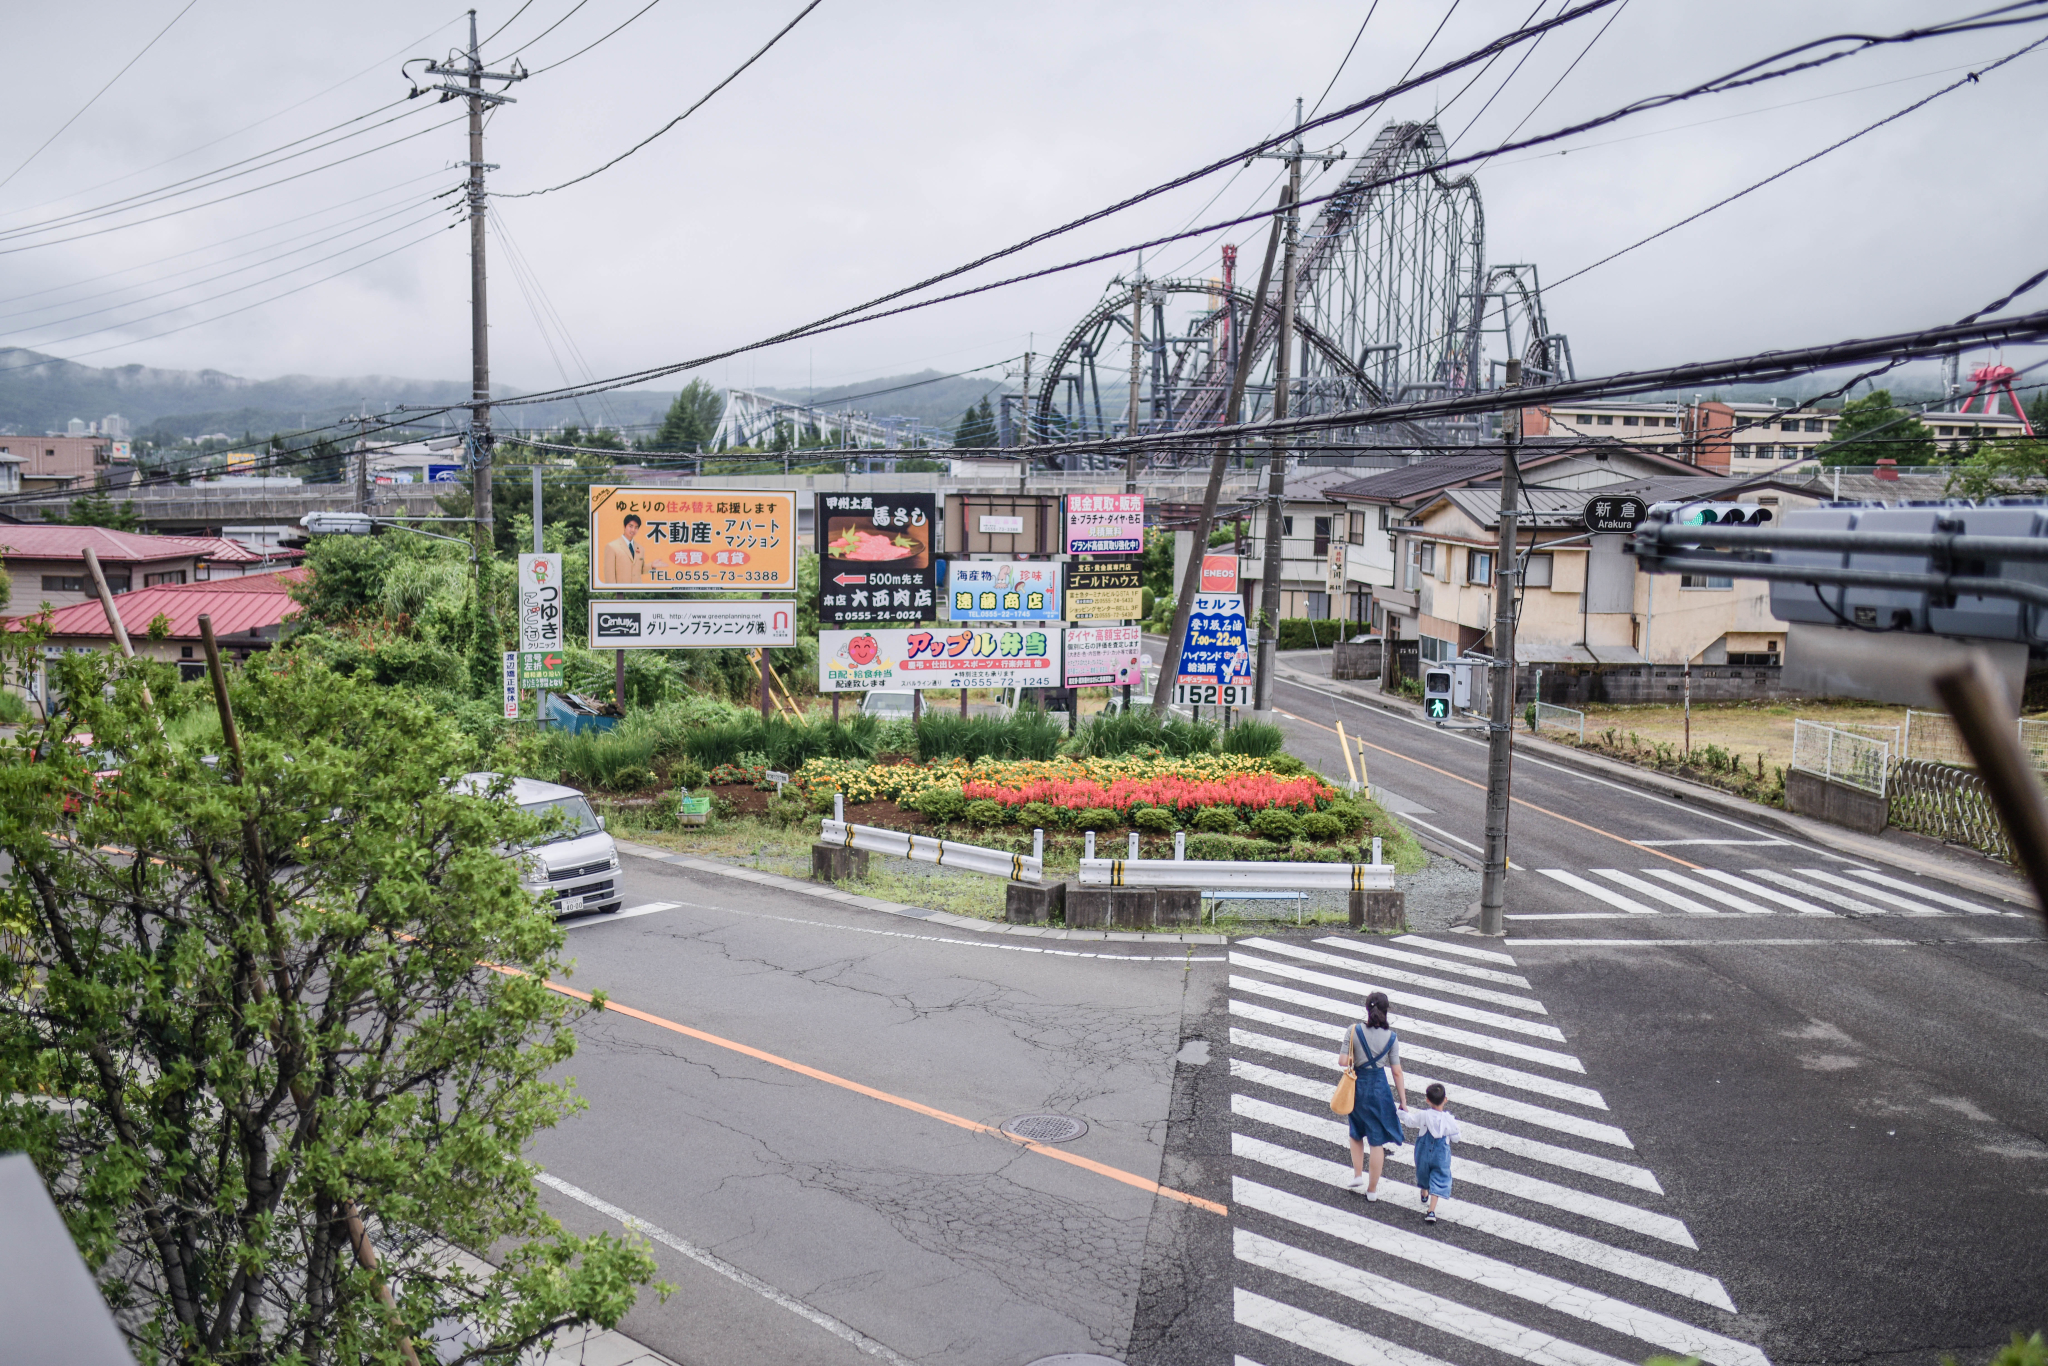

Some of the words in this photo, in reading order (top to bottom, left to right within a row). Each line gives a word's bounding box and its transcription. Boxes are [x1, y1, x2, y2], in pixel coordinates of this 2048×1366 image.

[616, 501, 777, 514] ゆとりの住み替え応援します
[826, 497, 873, 510] 甲州土産
[1070, 496, 1141, 512] 現金買取・販売
[872, 506, 926, 527] 馬さし
[1070, 513, 1141, 525] 金・プラチナ・ダイヤ・色石
[725, 519, 780, 534] アパート
[1598, 519, 1632, 529] Arakura
[1088, 526, 1122, 537] 見積無料
[725, 535, 780, 549] マンション
[674, 551, 704, 565] 売買
[715, 551, 745, 565] 賃貸
[1078, 563, 1132, 572] 宝石・貴金属専門店
[1203, 569, 1235, 578] ENEOS
[869, 573, 923, 585] 500m先左
[957, 570, 992, 581] 海産物
[1020, 570, 1043, 581] 珍味
[1070, 575, 1139, 588] ゴールドハウス
[823, 594, 847, 606] 本店
[851, 589, 932, 607] 大西肉店
[955, 591, 1044, 610] 遠藤商店
[1196, 599, 1241, 610] セルフ
[524, 591, 540, 642] こども
[540, 586, 558, 640] つゆき
[1191, 618, 1243, 631] 登り坂石油
[1068, 628, 1139, 642] ダイヤ・高額宝石は
[907, 630, 1047, 658] アップル弁当
[524, 653, 542, 663] 信号
[1183, 651, 1222, 661] ハイランド
[524, 662, 542, 671] 左折
[1187, 662, 1217, 673] 給油所
[828, 669, 892, 679] 日配・給食弁当
[1179, 675, 1209, 683] レギュラー
[1233, 676, 1244, 685] 灯油
[835, 679, 886, 688] 配達致します
[964, 678, 1050, 686] 0555-72-1245
[1179, 685, 1217, 705] 152
[1223, 686, 1247, 705] 91
